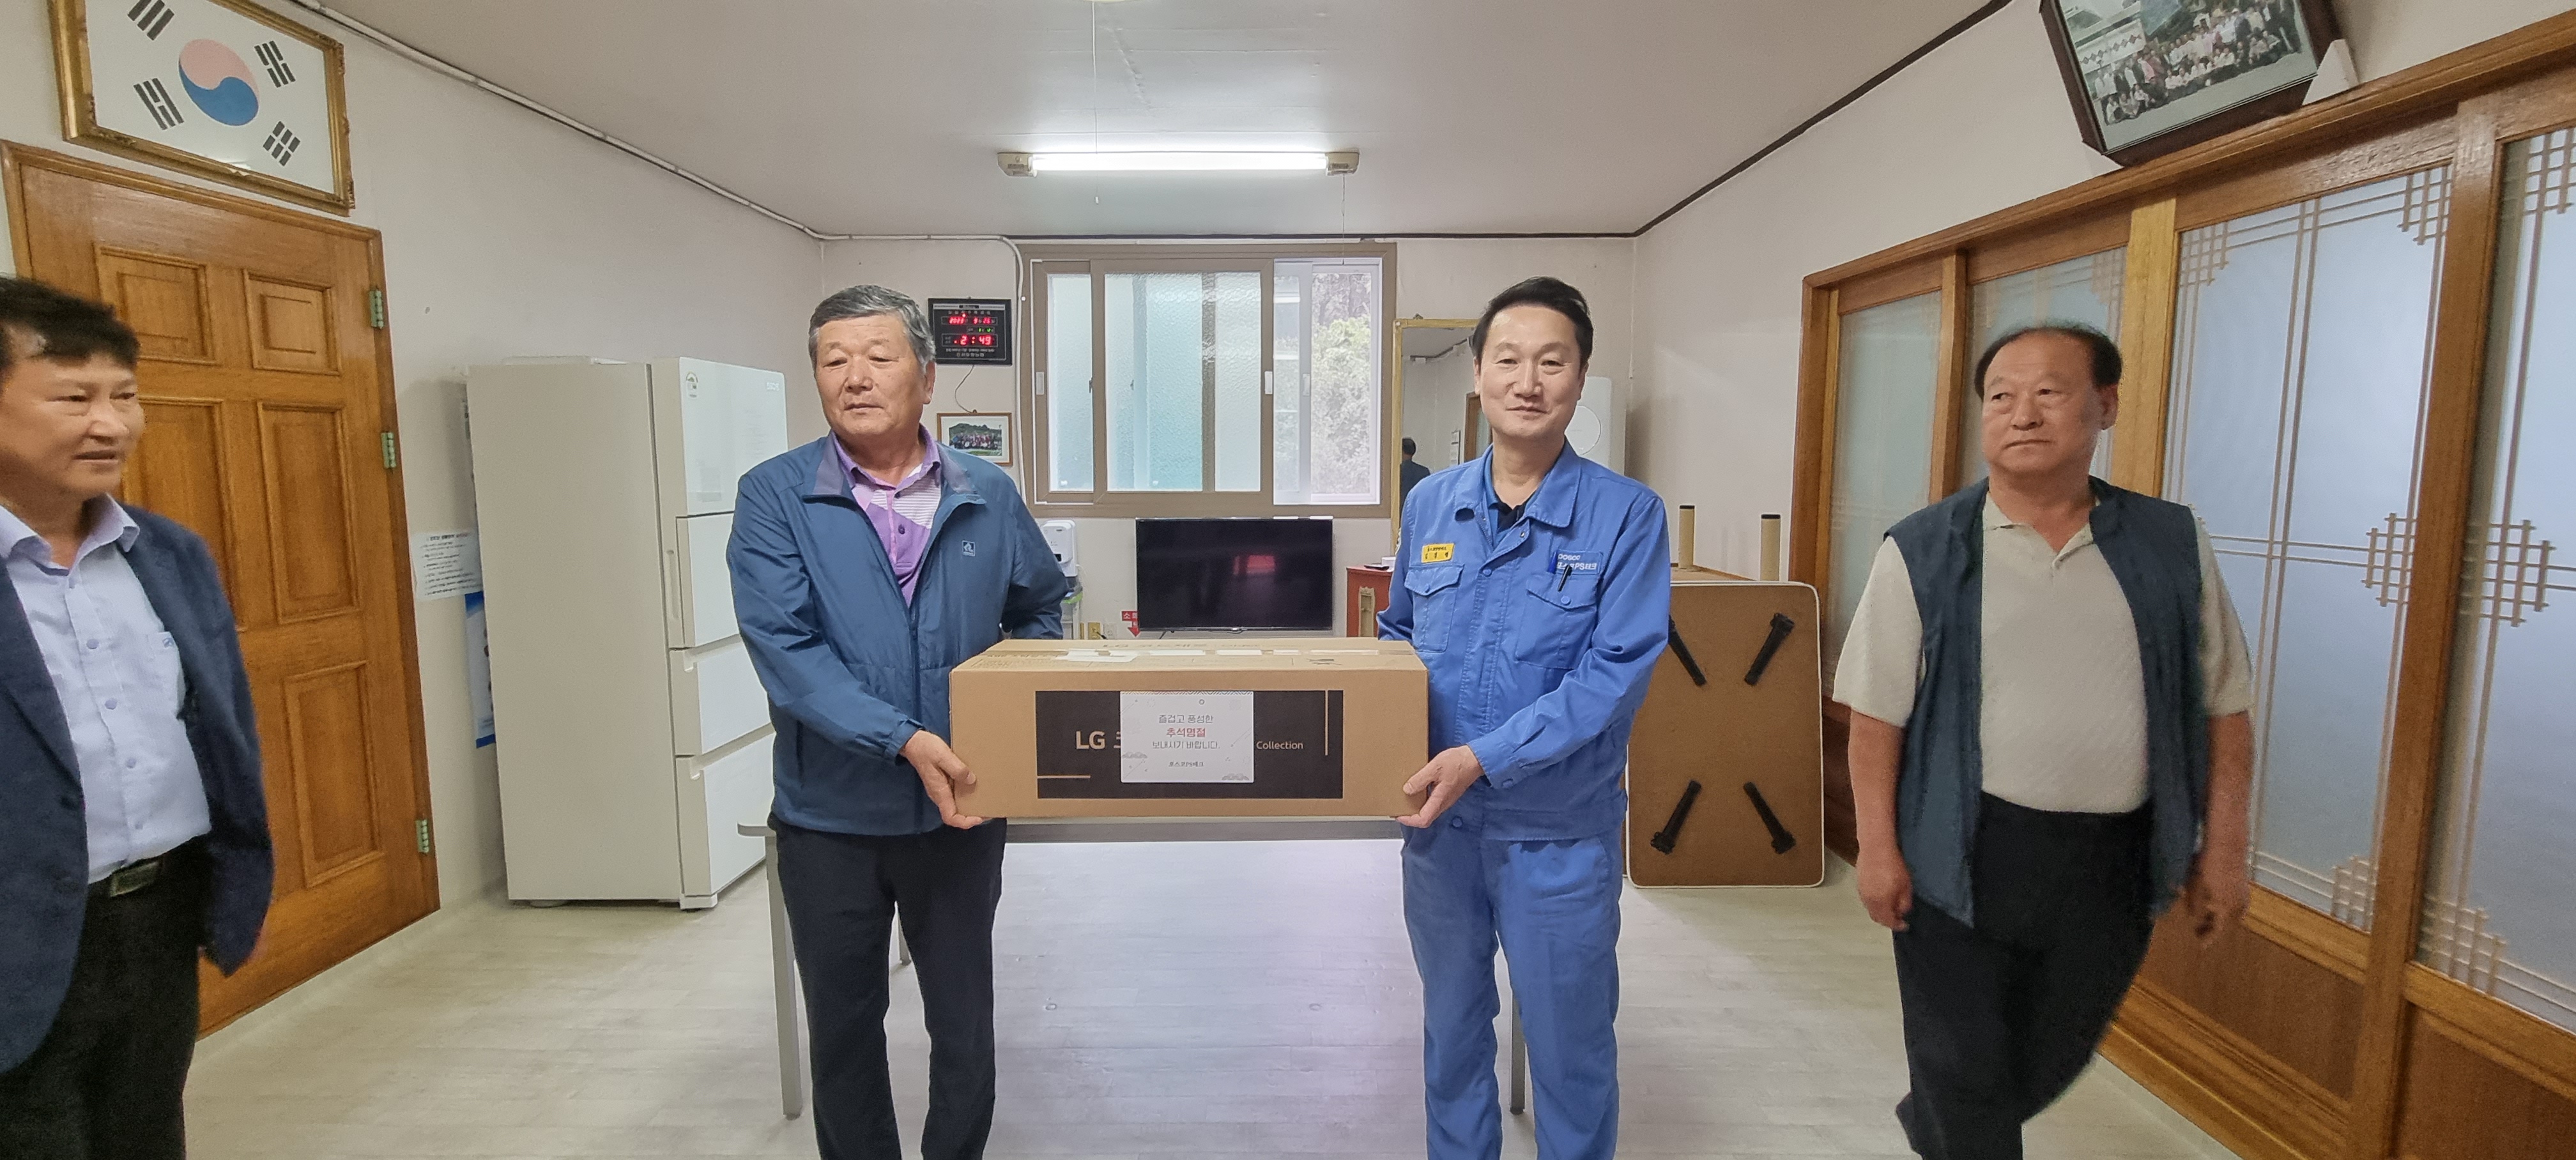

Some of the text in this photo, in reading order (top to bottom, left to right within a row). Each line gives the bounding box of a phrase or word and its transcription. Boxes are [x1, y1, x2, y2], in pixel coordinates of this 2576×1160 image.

[1159, 715, 1213, 724] 즐겁고 풍성한
[1167, 728, 1206, 738] 추석명절
[1076, 731, 1105, 749] LG
[1256, 741, 1303, 749] Collection
